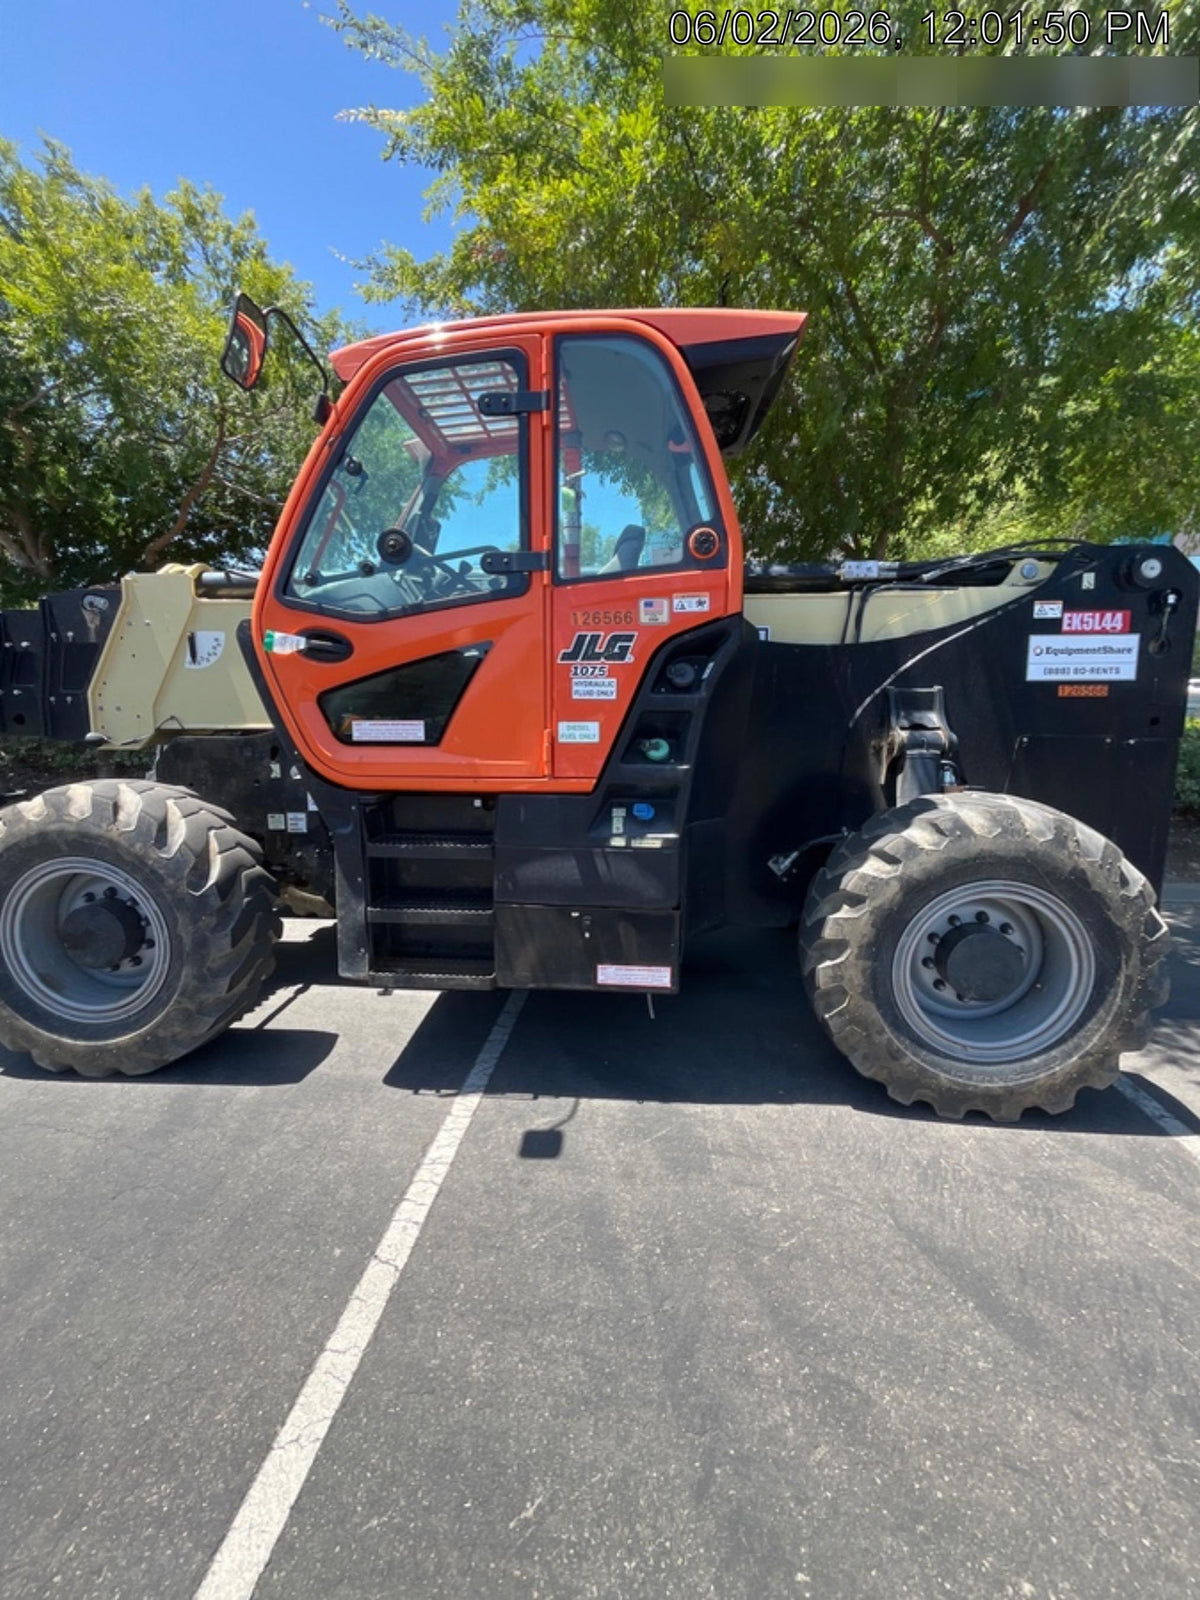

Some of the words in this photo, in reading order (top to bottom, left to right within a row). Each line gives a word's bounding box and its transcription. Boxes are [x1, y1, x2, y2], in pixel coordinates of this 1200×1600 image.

[571, 611, 634, 625] 126566
[1063, 613, 1124, 632] EK5L44
[558, 632, 637, 663] JLG
[1045, 645, 1133, 656] EquipmentShare
[571, 665, 608, 678] 1075
[574, 680, 615, 689] HYDRAULIC
[596, 689, 615, 698] ONLY
